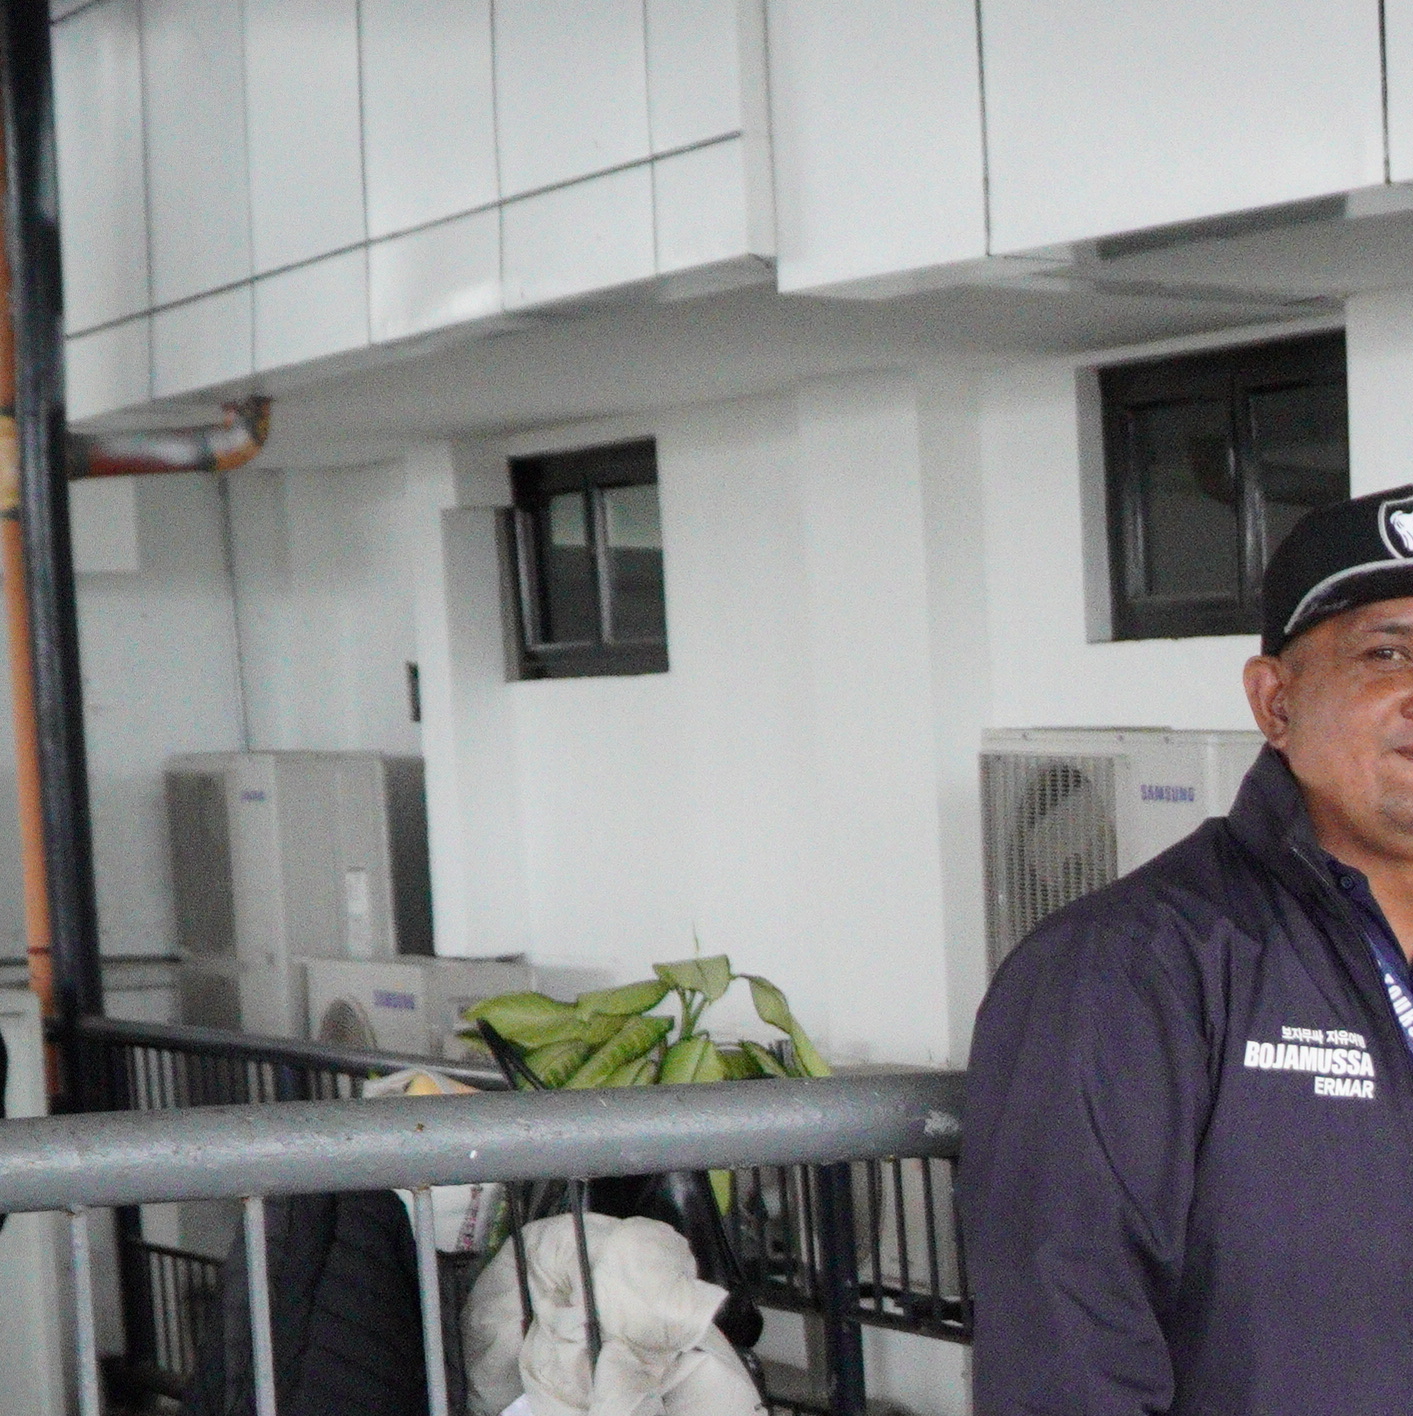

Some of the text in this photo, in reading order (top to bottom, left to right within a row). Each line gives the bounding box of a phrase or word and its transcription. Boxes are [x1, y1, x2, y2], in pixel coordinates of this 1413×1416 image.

[1140, 784, 1195, 802] SAMSUNG
[1282, 1026, 1324, 1044] 보자무싸
[1244, 1040, 1375, 1077] BOJAMUSSA
[1314, 1076, 1374, 1099] ERMAR
